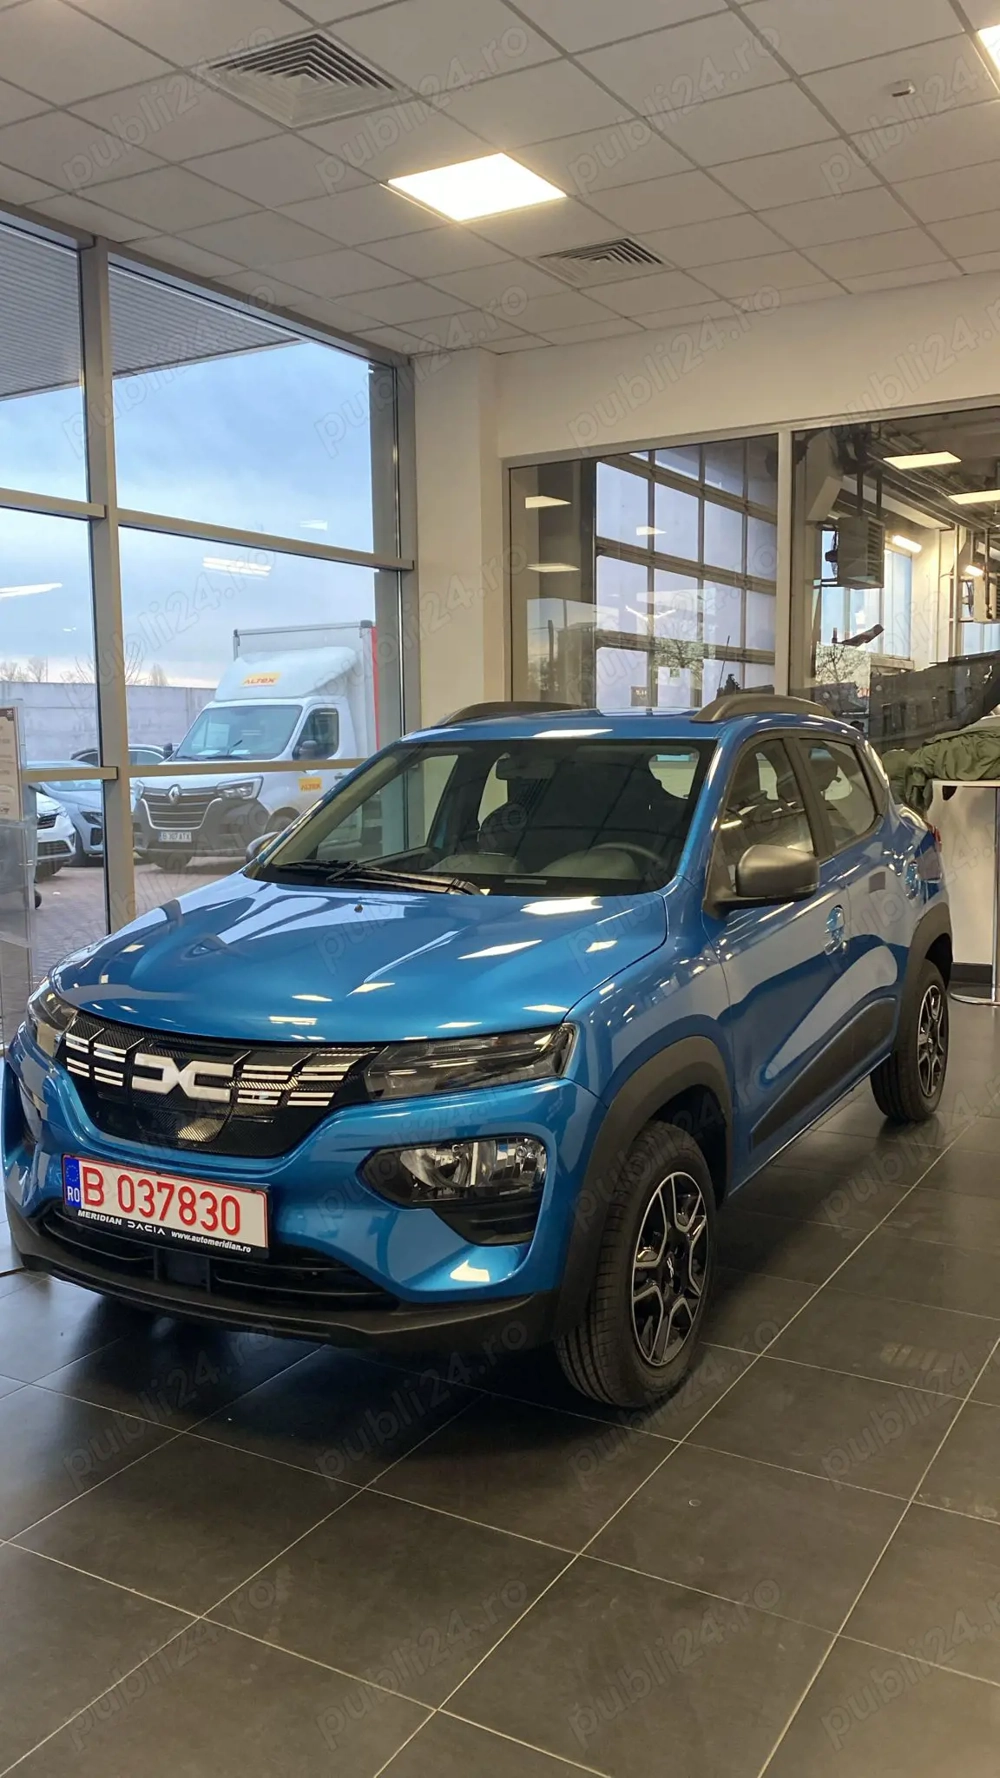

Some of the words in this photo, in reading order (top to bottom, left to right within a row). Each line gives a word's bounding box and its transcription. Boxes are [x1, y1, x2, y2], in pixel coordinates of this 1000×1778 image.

[243, 677, 276, 685] ALTEX
[67, 1186, 80, 1203] RO
[82, 1166, 104, 1206] B
[117, 1174, 241, 1236] 037830
[77, 1210, 122, 1226] MERIDIAN
[127, 1220, 166, 1236] DACIA
[171, 1231, 252, 1253] www.automeridian.ro
